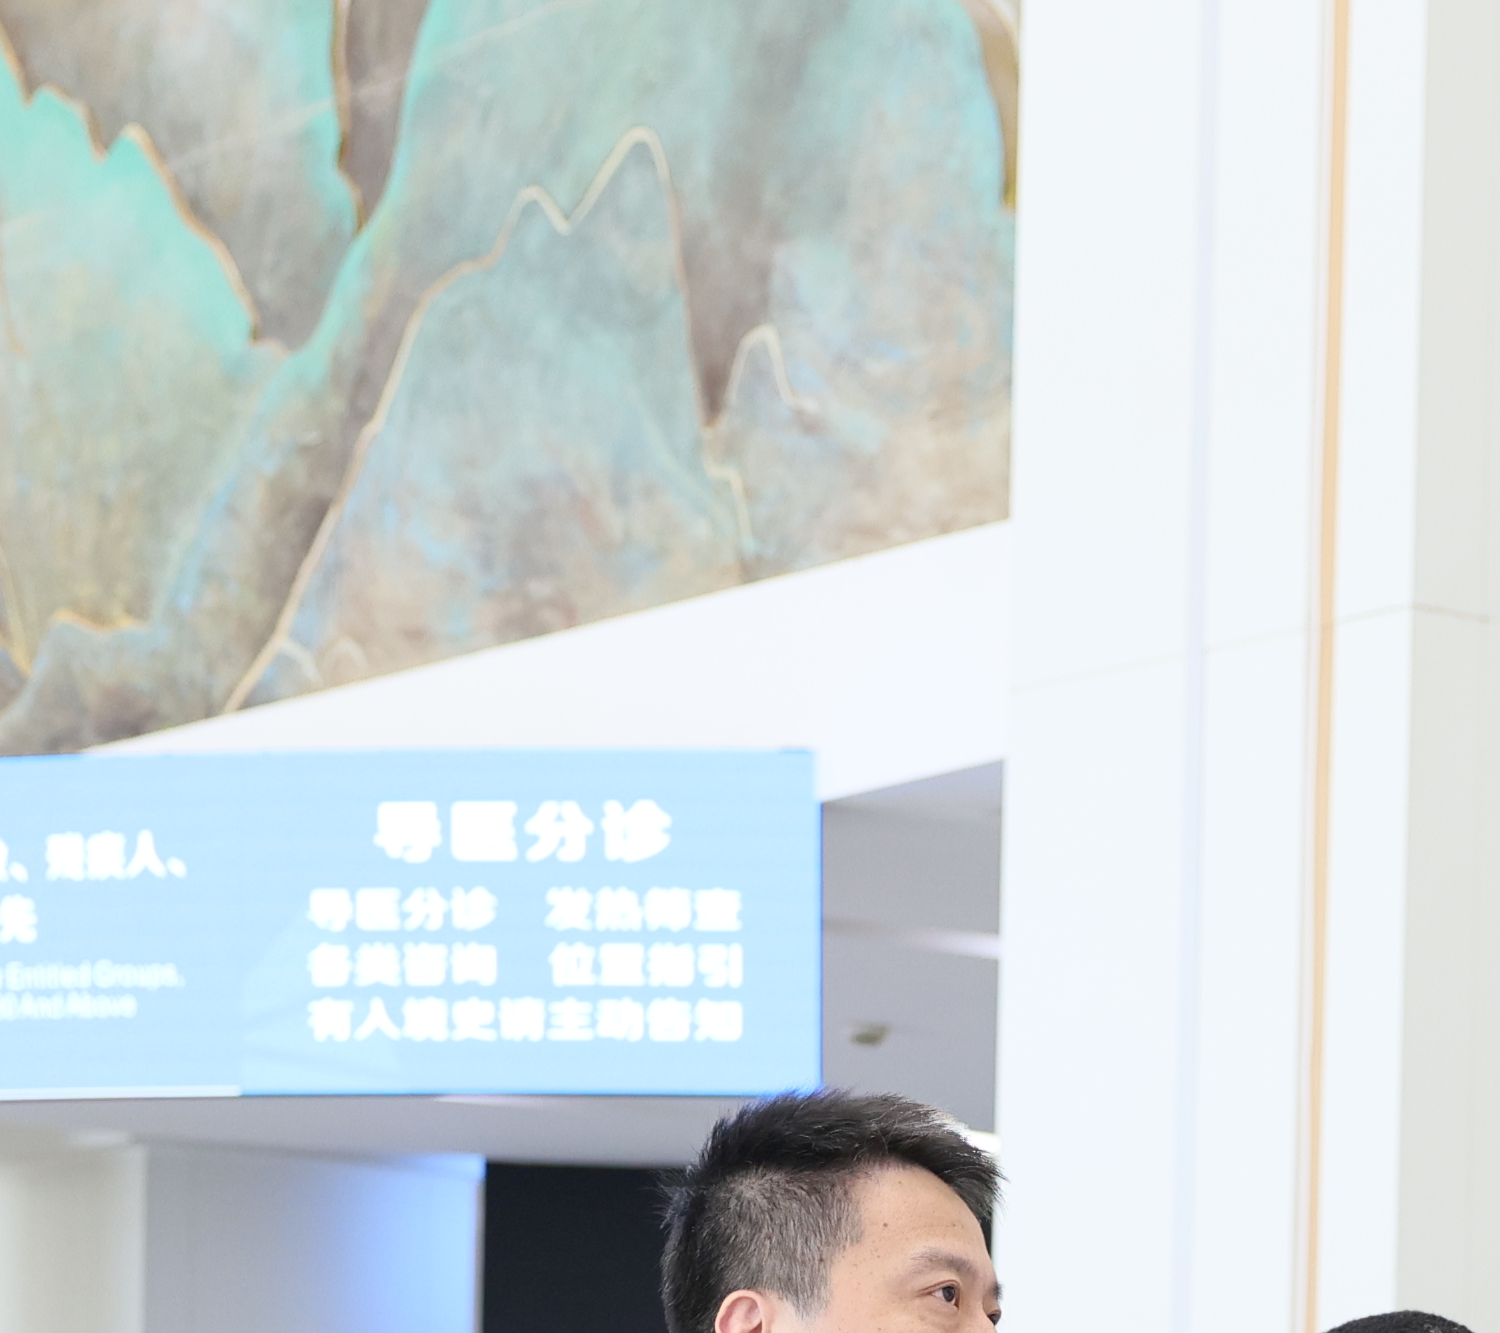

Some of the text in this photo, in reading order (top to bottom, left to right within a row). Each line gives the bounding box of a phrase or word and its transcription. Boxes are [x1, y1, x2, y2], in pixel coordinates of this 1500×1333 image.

[373, 799, 672, 863] 导医分诊
[306, 886, 497, 932] 导医分诊
[548, 941, 744, 987] 位置指引
